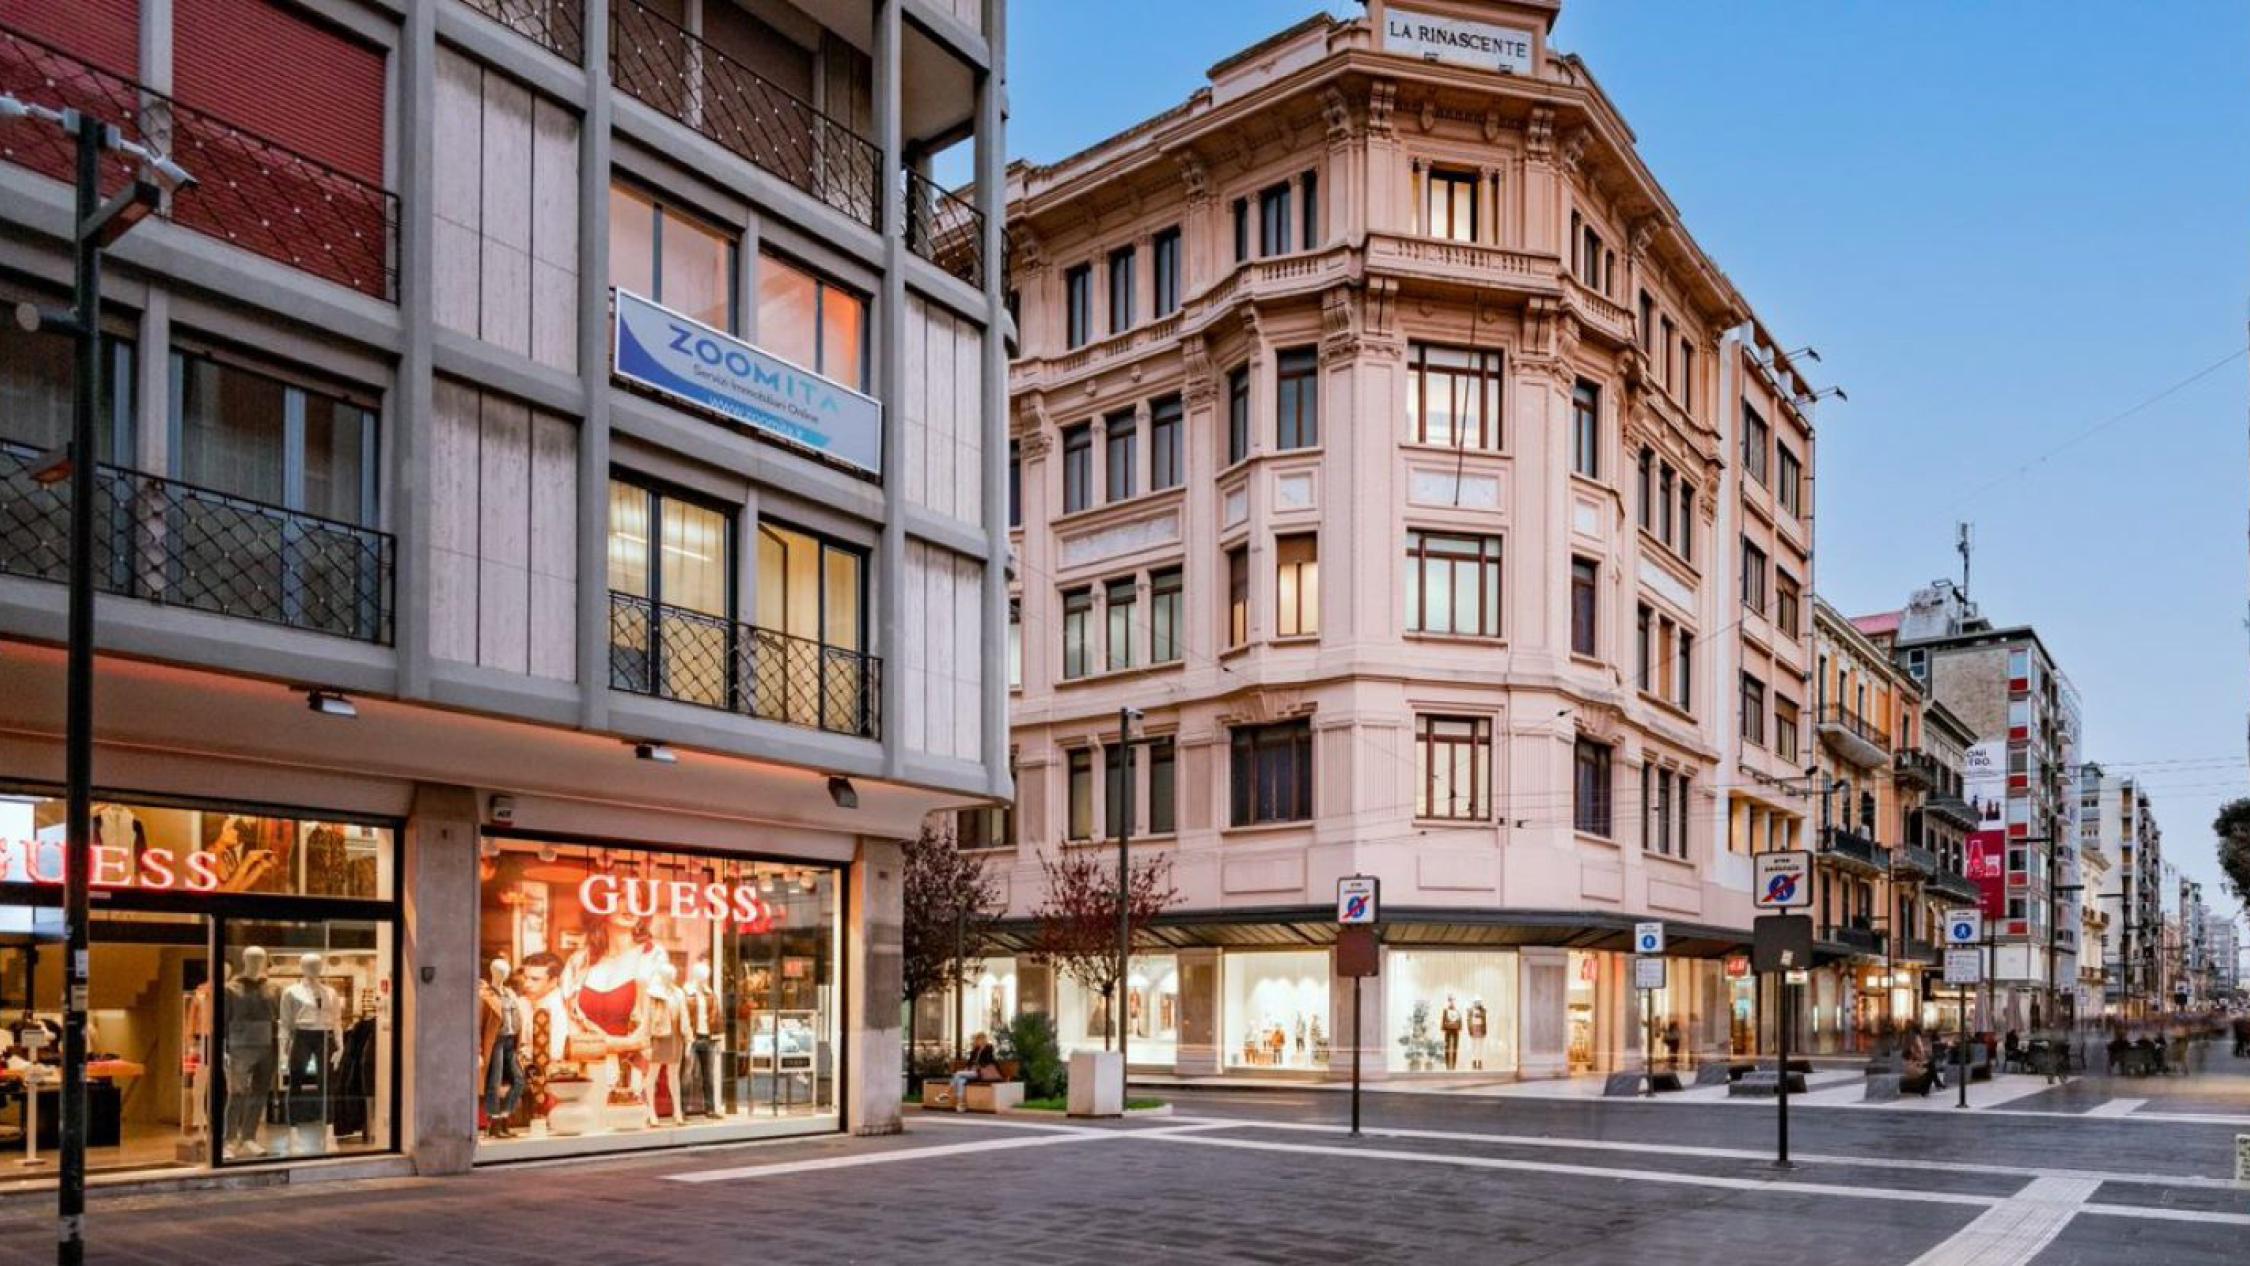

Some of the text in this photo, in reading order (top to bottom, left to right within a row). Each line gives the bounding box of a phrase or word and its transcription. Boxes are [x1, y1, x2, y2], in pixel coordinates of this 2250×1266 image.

[1390, 21, 1527, 58] LA RINASCENTE
[669, 323, 839, 411] ZOOMITA
[0, 836, 218, 892] UESS
[578, 873, 759, 923] GUESS
